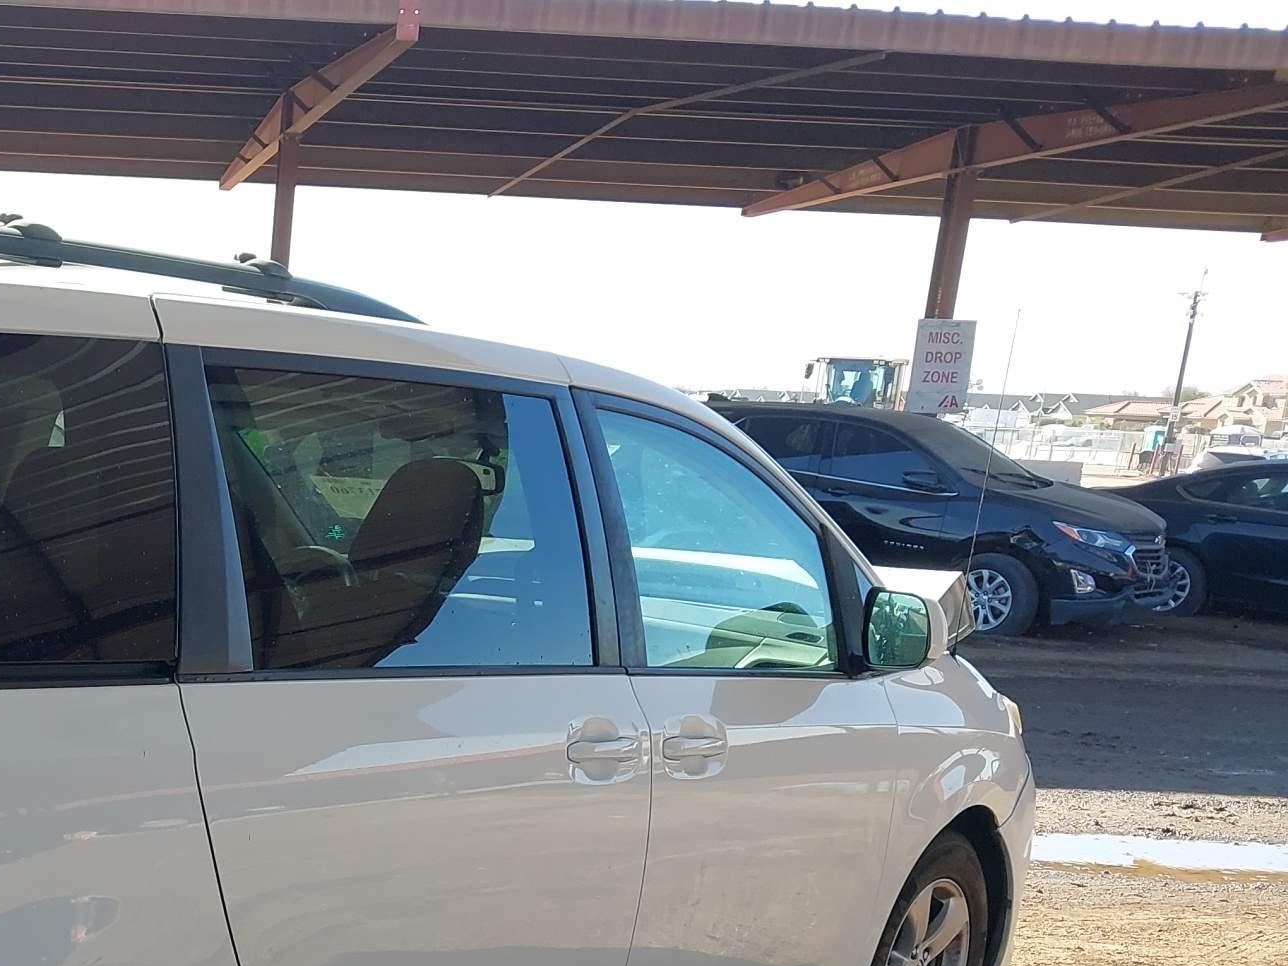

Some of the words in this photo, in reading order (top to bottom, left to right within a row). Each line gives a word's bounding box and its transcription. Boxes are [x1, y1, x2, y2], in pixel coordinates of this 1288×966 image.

[927, 331, 963, 345] MISC.
[924, 351, 962, 364] DROP
[921, 371, 959, 383] ZONE
